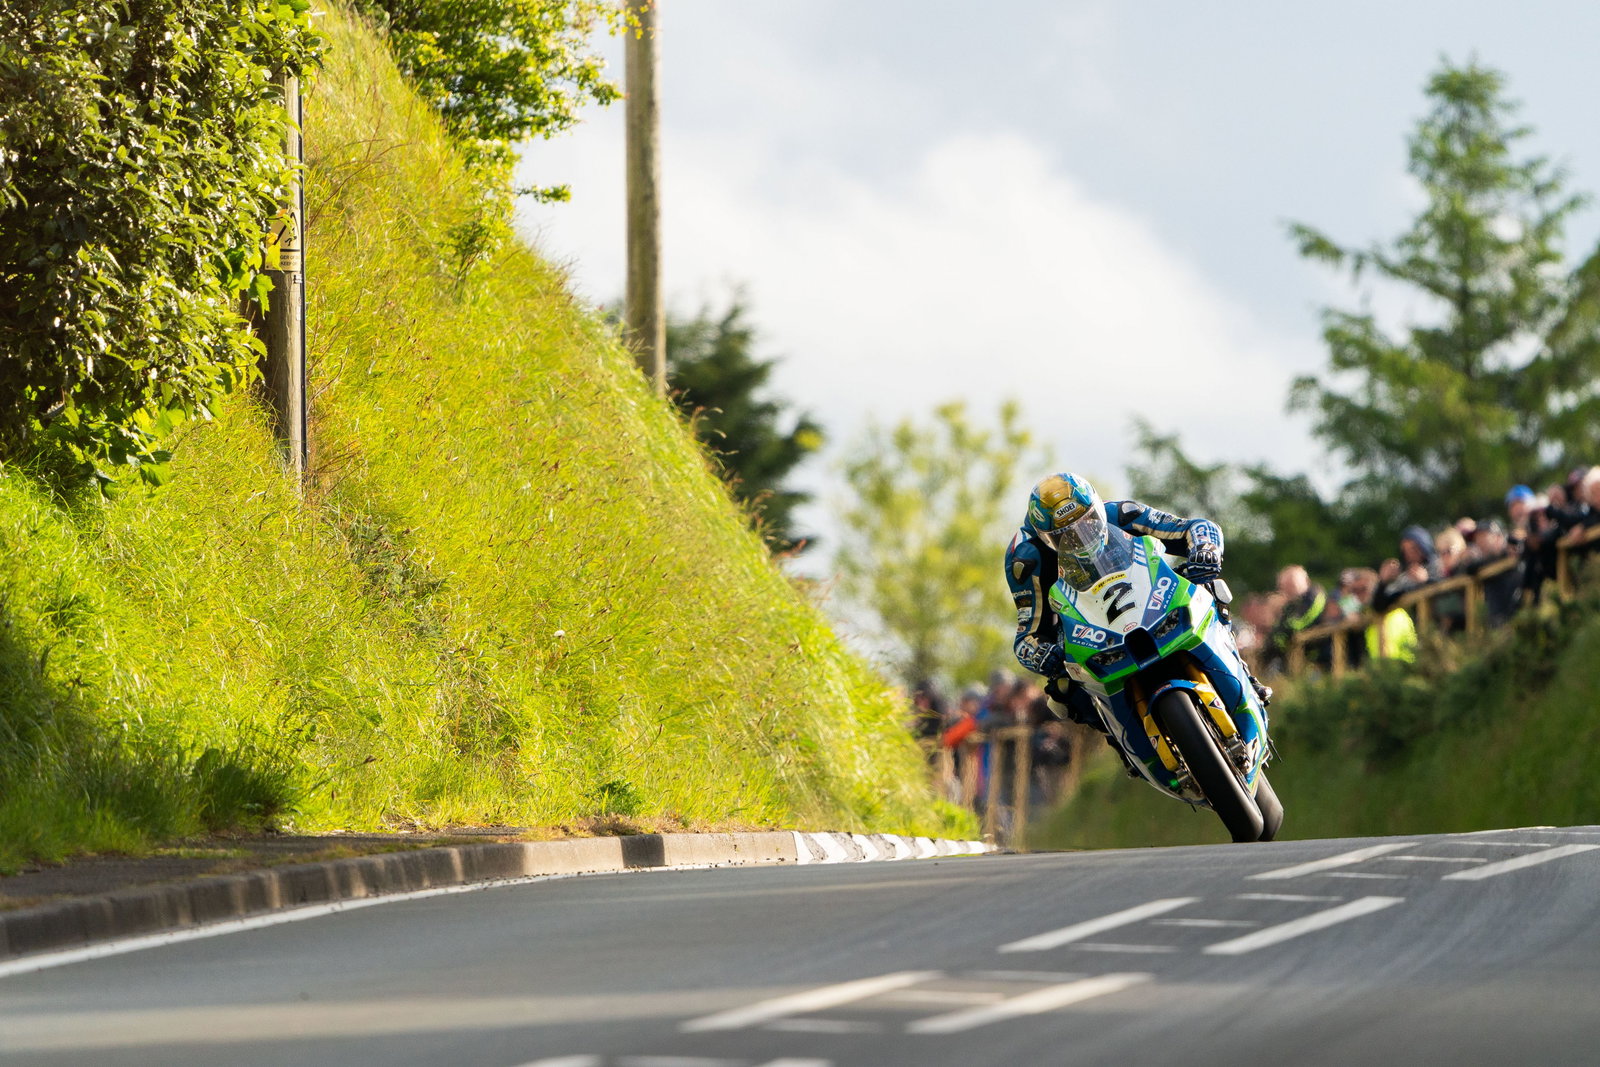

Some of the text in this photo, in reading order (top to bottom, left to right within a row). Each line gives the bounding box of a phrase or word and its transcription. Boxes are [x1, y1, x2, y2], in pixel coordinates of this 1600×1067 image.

[1056, 502, 1075, 517] SHOEI
[1103, 581, 1135, 625] 2
[1163, 582, 1177, 609] RACING
[1072, 640, 1099, 648] RACING
